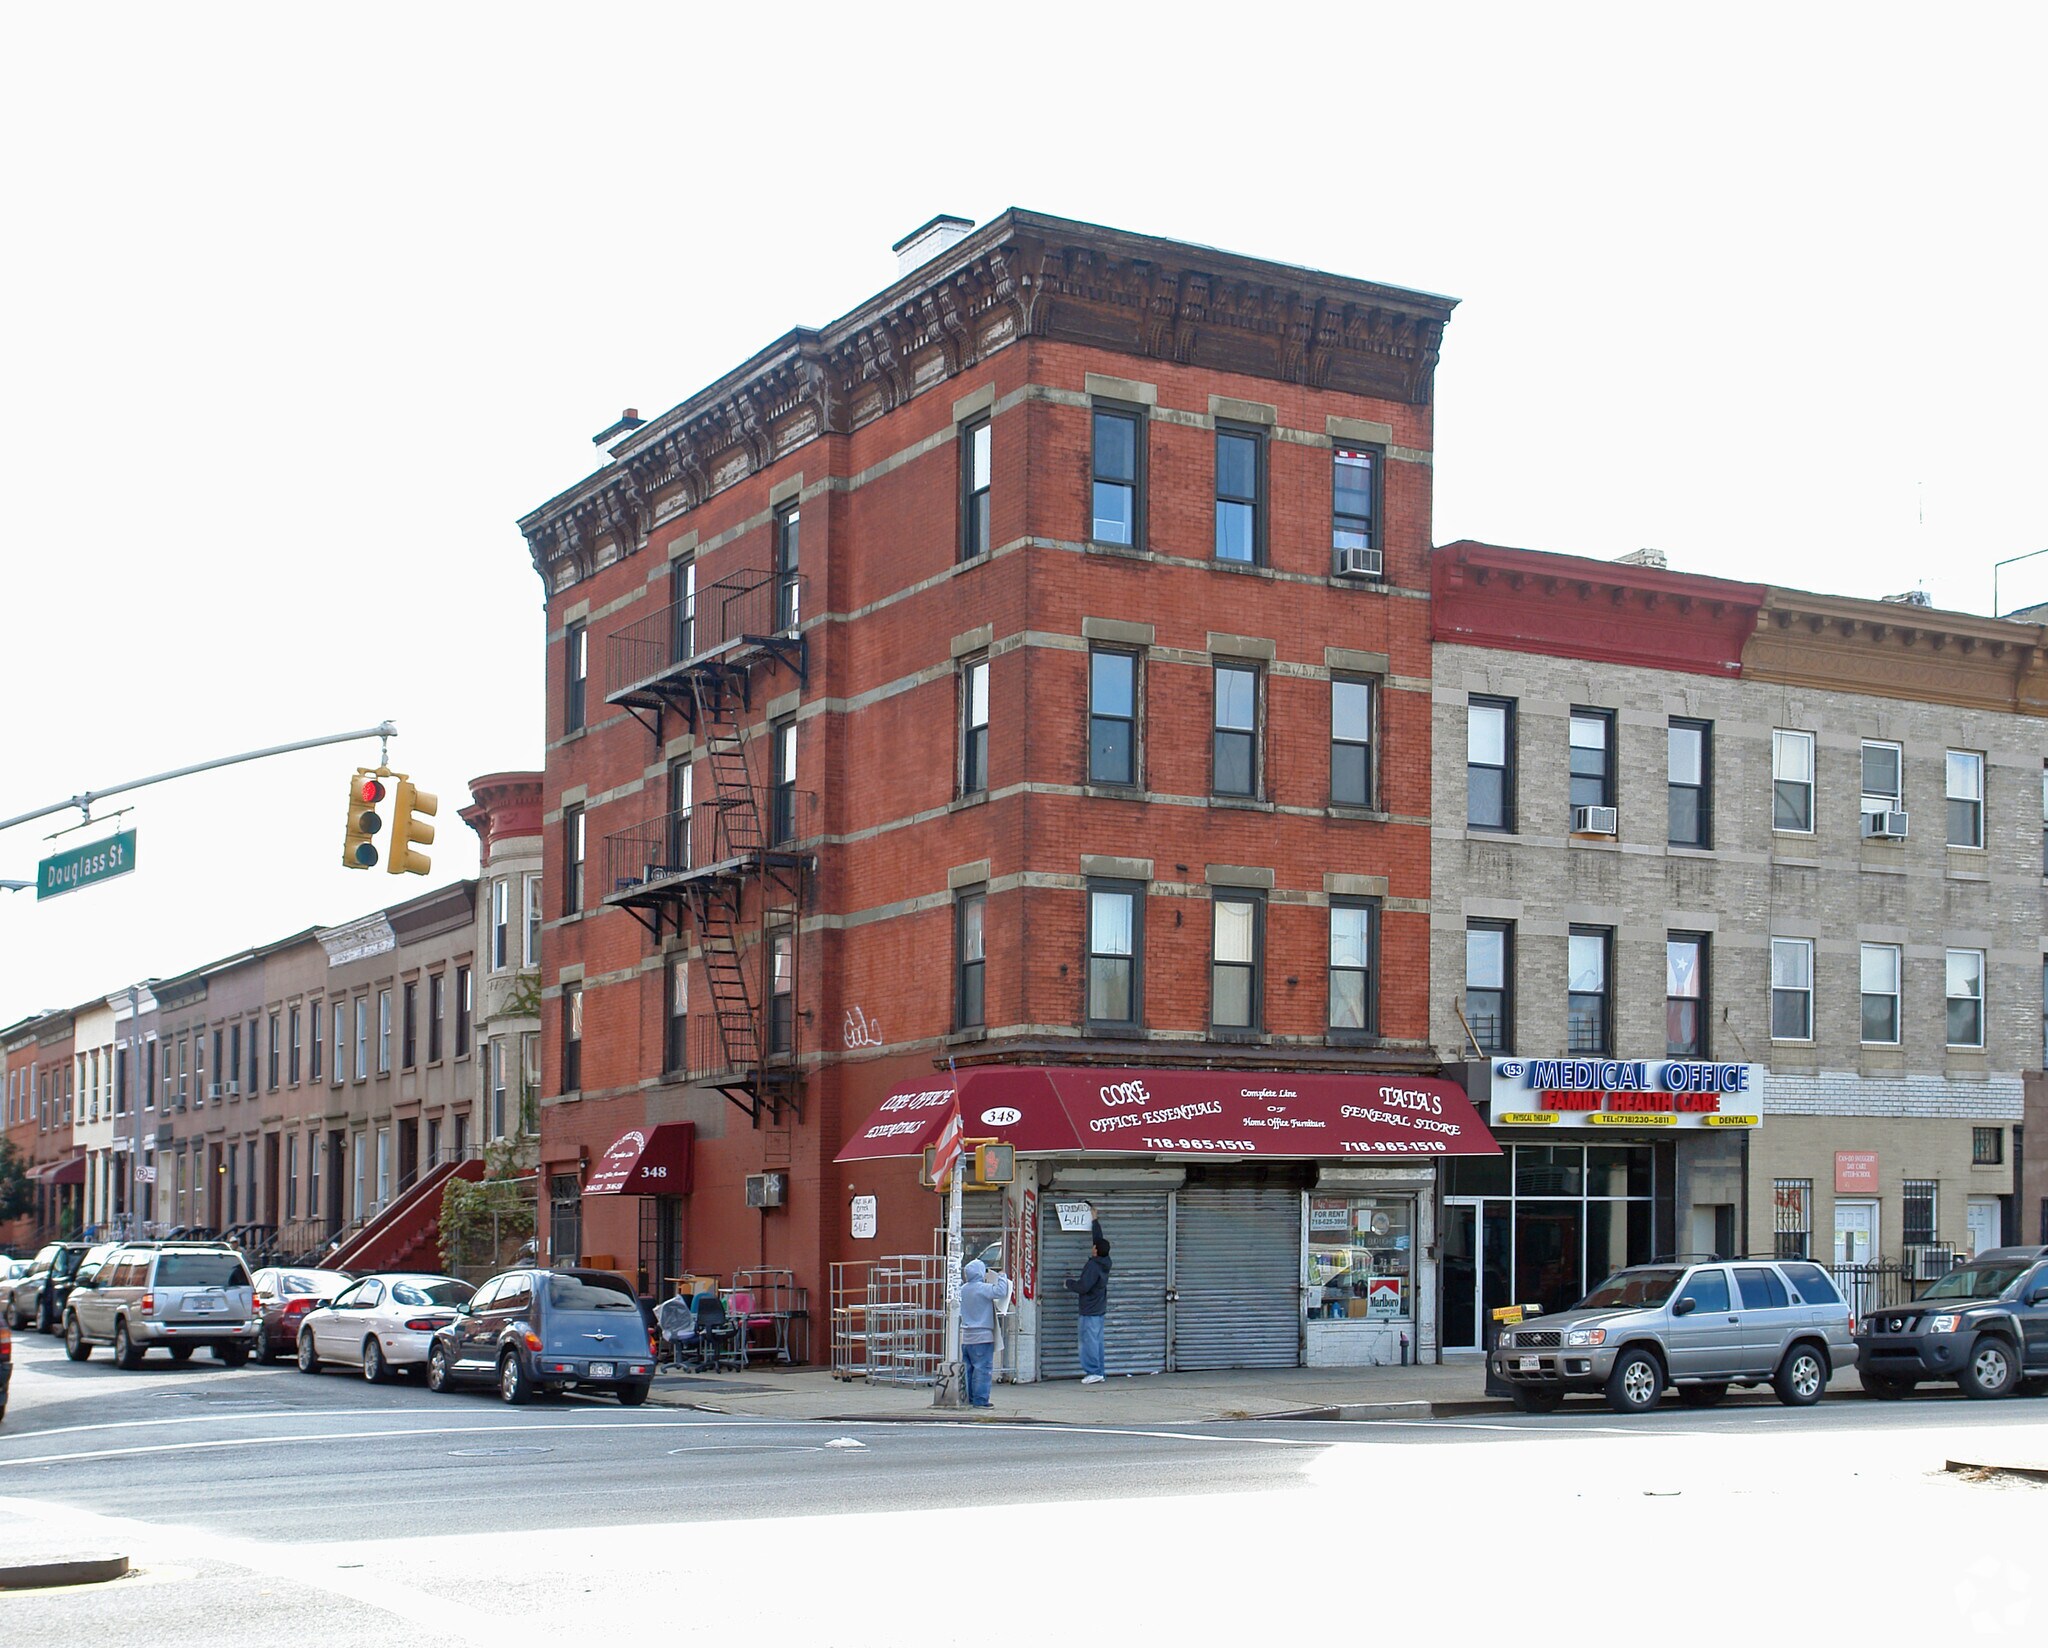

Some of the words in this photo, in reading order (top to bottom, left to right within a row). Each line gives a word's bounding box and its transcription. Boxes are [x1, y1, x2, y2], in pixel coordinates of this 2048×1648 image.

[47, 853, 106, 888] Douglass
[109, 843, 123, 868] St
[1506, 1065, 1523, 1075] 153
[1532, 1060, 1653, 1089] MEDICAL
[1664, 1062, 1750, 1092] OFFICE
[1100, 1079, 1150, 1107] CORE
[1241, 1088, 1277, 1099] Complete
[1278, 1089, 1297, 1098] Line
[1379, 1086, 1443, 1115] TATA'S
[1545, 1091, 1605, 1111] FAMILY
[1610, 1092, 1673, 1112] HEALTH
[1677, 1093, 1720, 1112] CARE
[987, 1109, 1015, 1122] 348
[1089, 1113, 1142, 1132] OFFICE
[1142, 1101, 1222, 1124] ESSENTIALS
[1340, 1105, 1411, 1127] GENERAL
[1413, 1118, 1461, 1136] STORE
[1718, 1116, 1748, 1124] DENTAL
[1243, 1117, 1266, 1127] Home
[1267, 1117, 1290, 1129] Office
[1291, 1118, 1326, 1128] Furniture
[1141, 1137, 1256, 1151] 718-965-1515
[1340, 1141, 1447, 1152] 718-965-1516
[641, 1166, 667, 1178] 348
[1025, 1199, 1035, 1294] Budweiser
[1370, 1294, 1399, 1308] Marlboro
